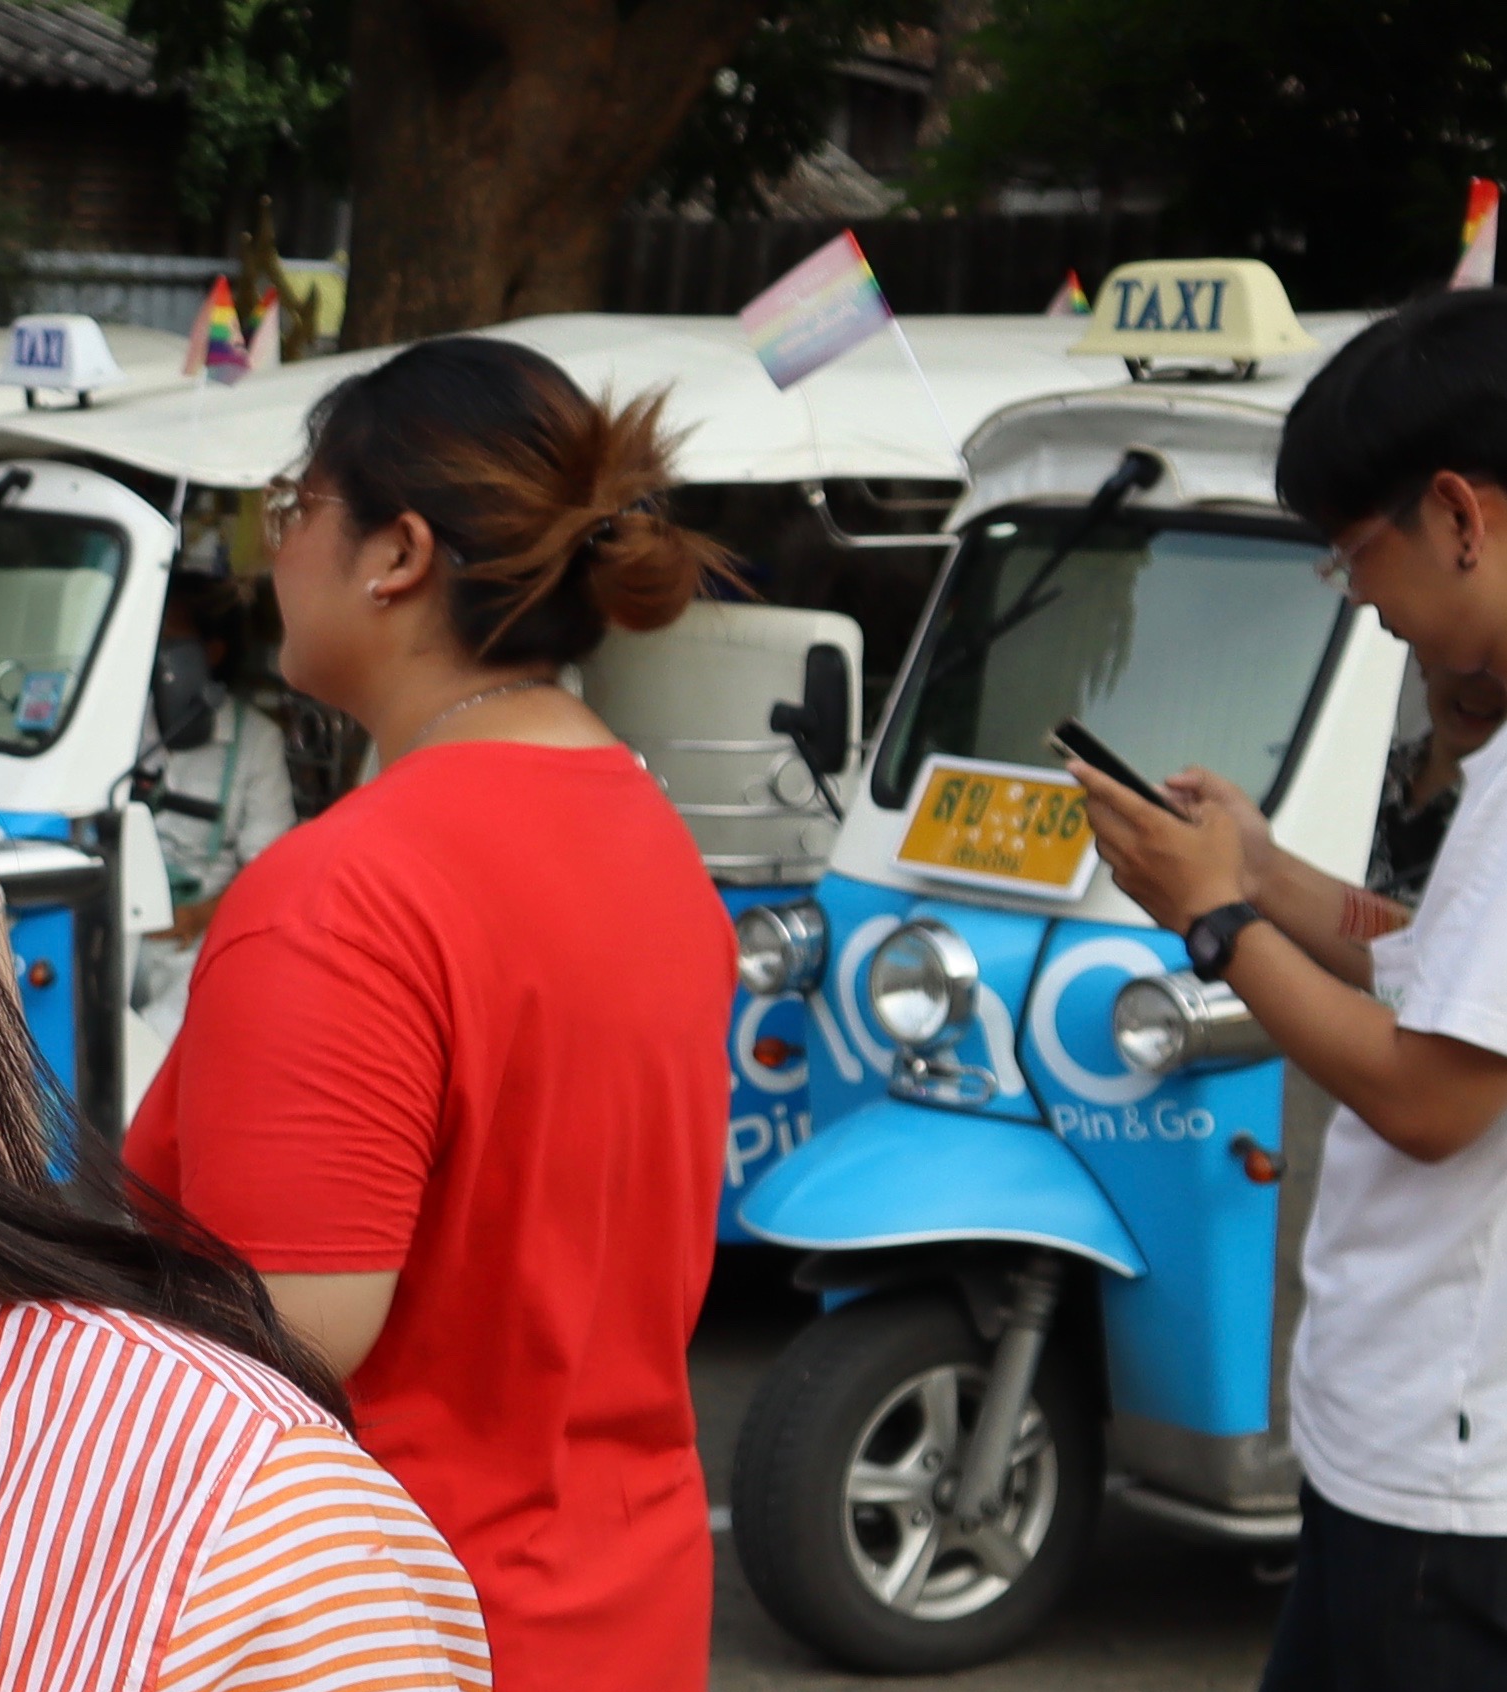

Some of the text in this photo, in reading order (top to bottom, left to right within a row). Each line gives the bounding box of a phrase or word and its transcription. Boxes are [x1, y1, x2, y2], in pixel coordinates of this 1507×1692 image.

[1114, 278, 1229, 332] TAXI
[15, 327, 65, 369] TAXI
[1052, 1099, 1216, 1141] Pin & Go
